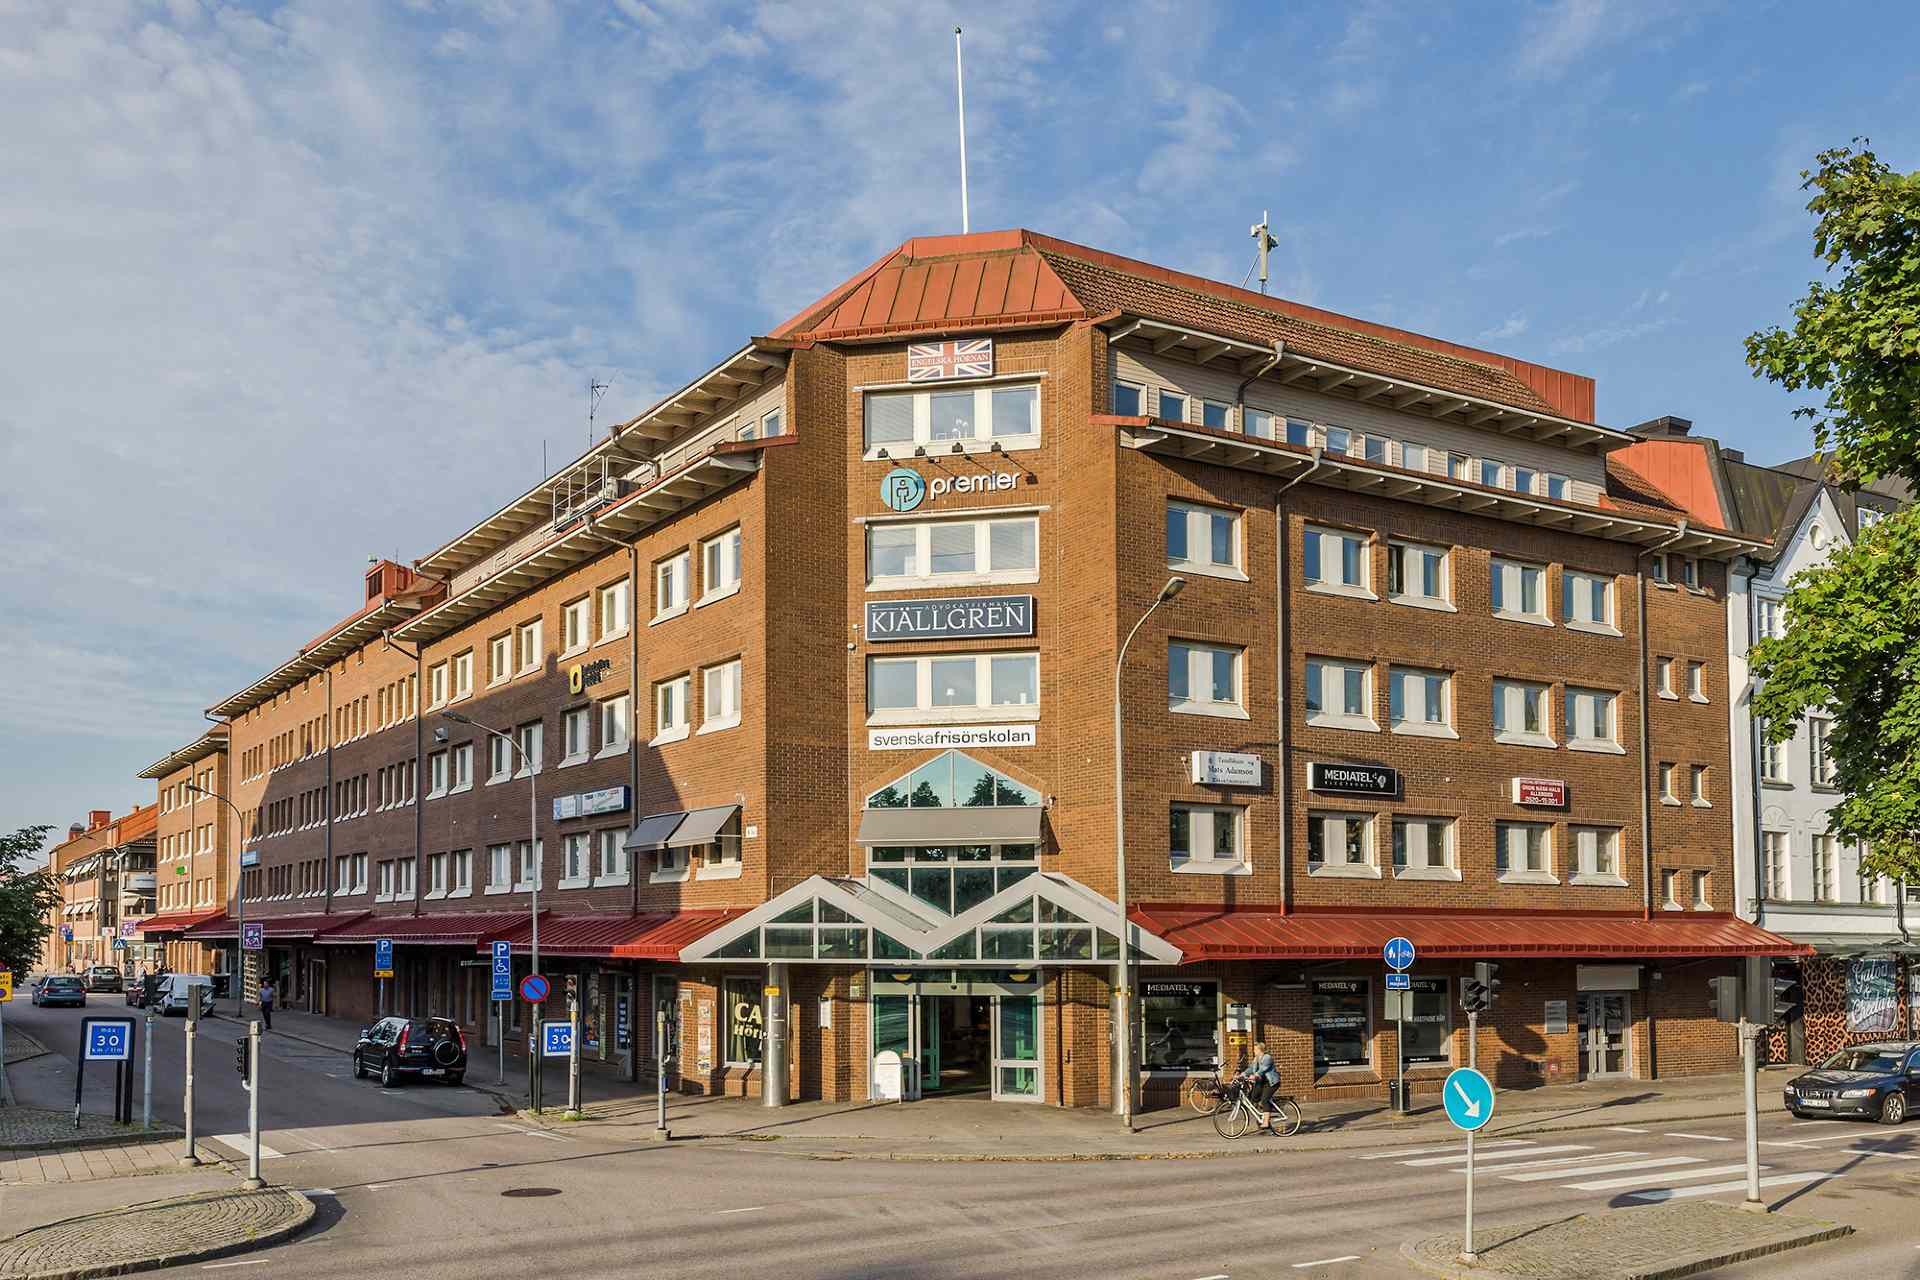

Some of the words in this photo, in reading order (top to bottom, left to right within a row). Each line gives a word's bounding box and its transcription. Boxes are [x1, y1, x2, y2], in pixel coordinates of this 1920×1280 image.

[930, 470, 1021, 500] premier
[871, 605, 1025, 633] KJÄLLGREN
[873, 729, 1031, 746] svenskafrisörskolan
[1324, 769, 1373, 783] MEDIATEL
[381, 940, 389, 951] P
[497, 943, 507, 955] P
[1147, 984, 1187, 992] MEDIATEL
[734, 1002, 763, 1025] CA
[96, 1035, 119, 1046] 30
[551, 1034, 569, 1044] 30
